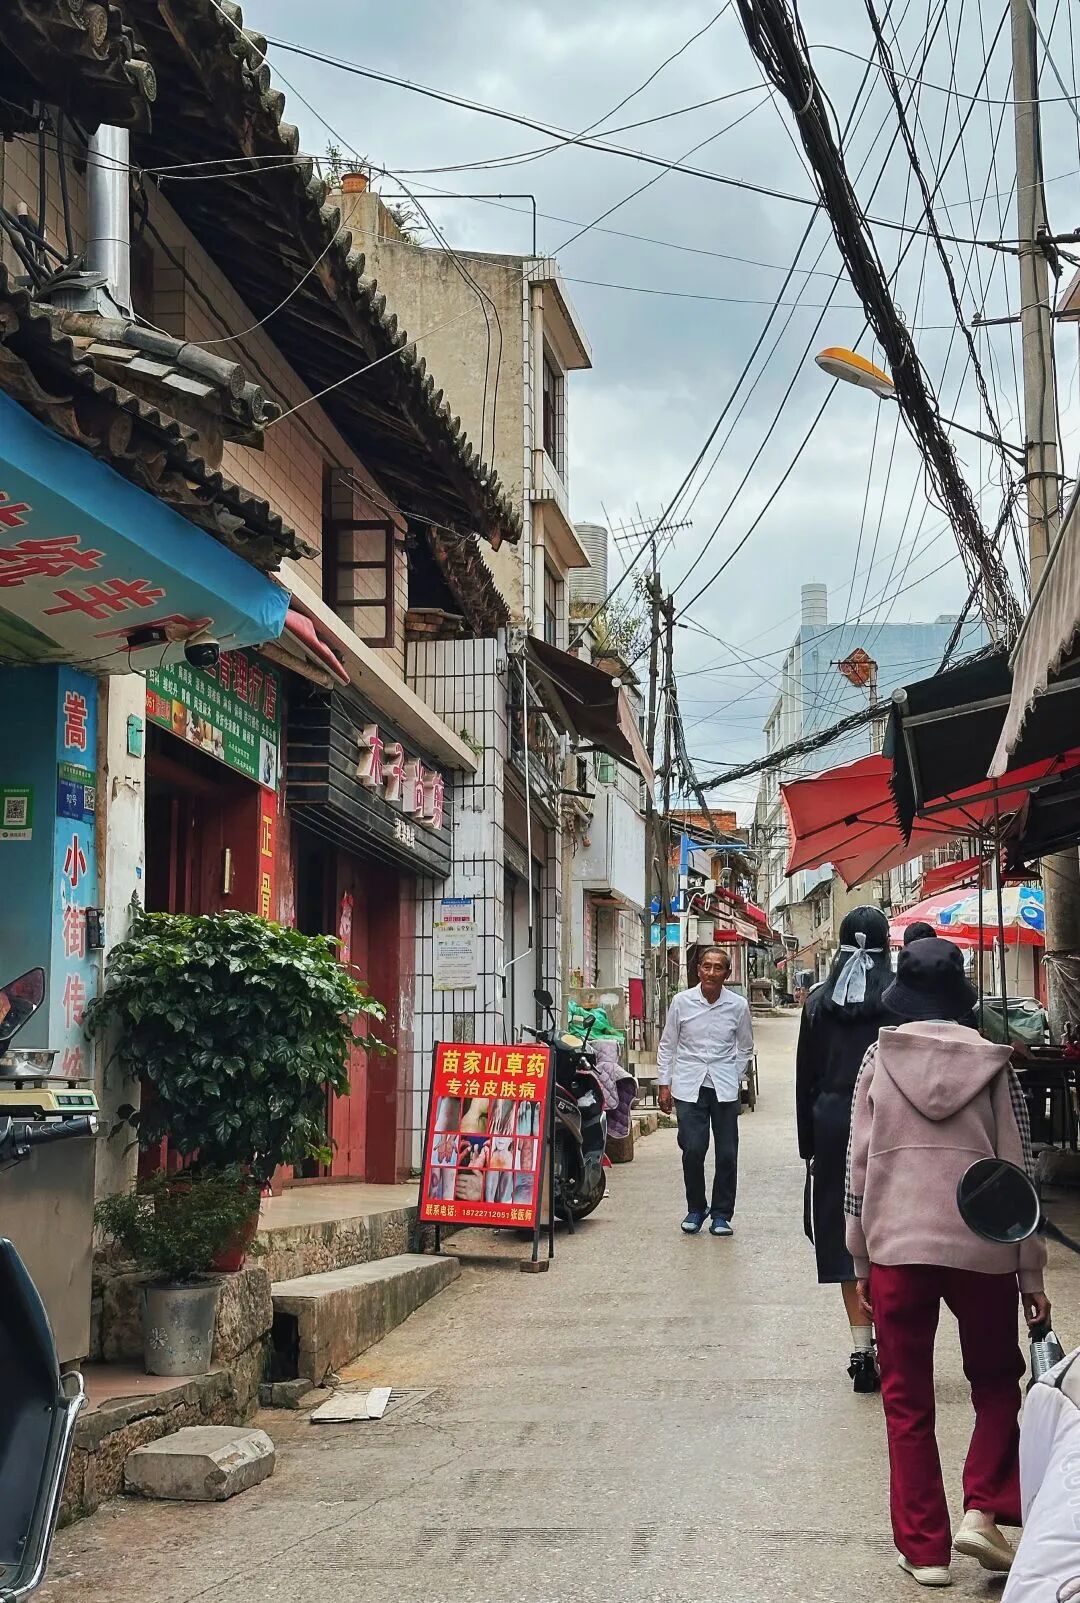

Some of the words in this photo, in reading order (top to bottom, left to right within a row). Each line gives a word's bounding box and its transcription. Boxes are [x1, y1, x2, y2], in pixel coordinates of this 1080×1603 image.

[442, 1050, 546, 1078] 苗家山草药
[446, 1078, 536, 1099] 专治皮肤病
